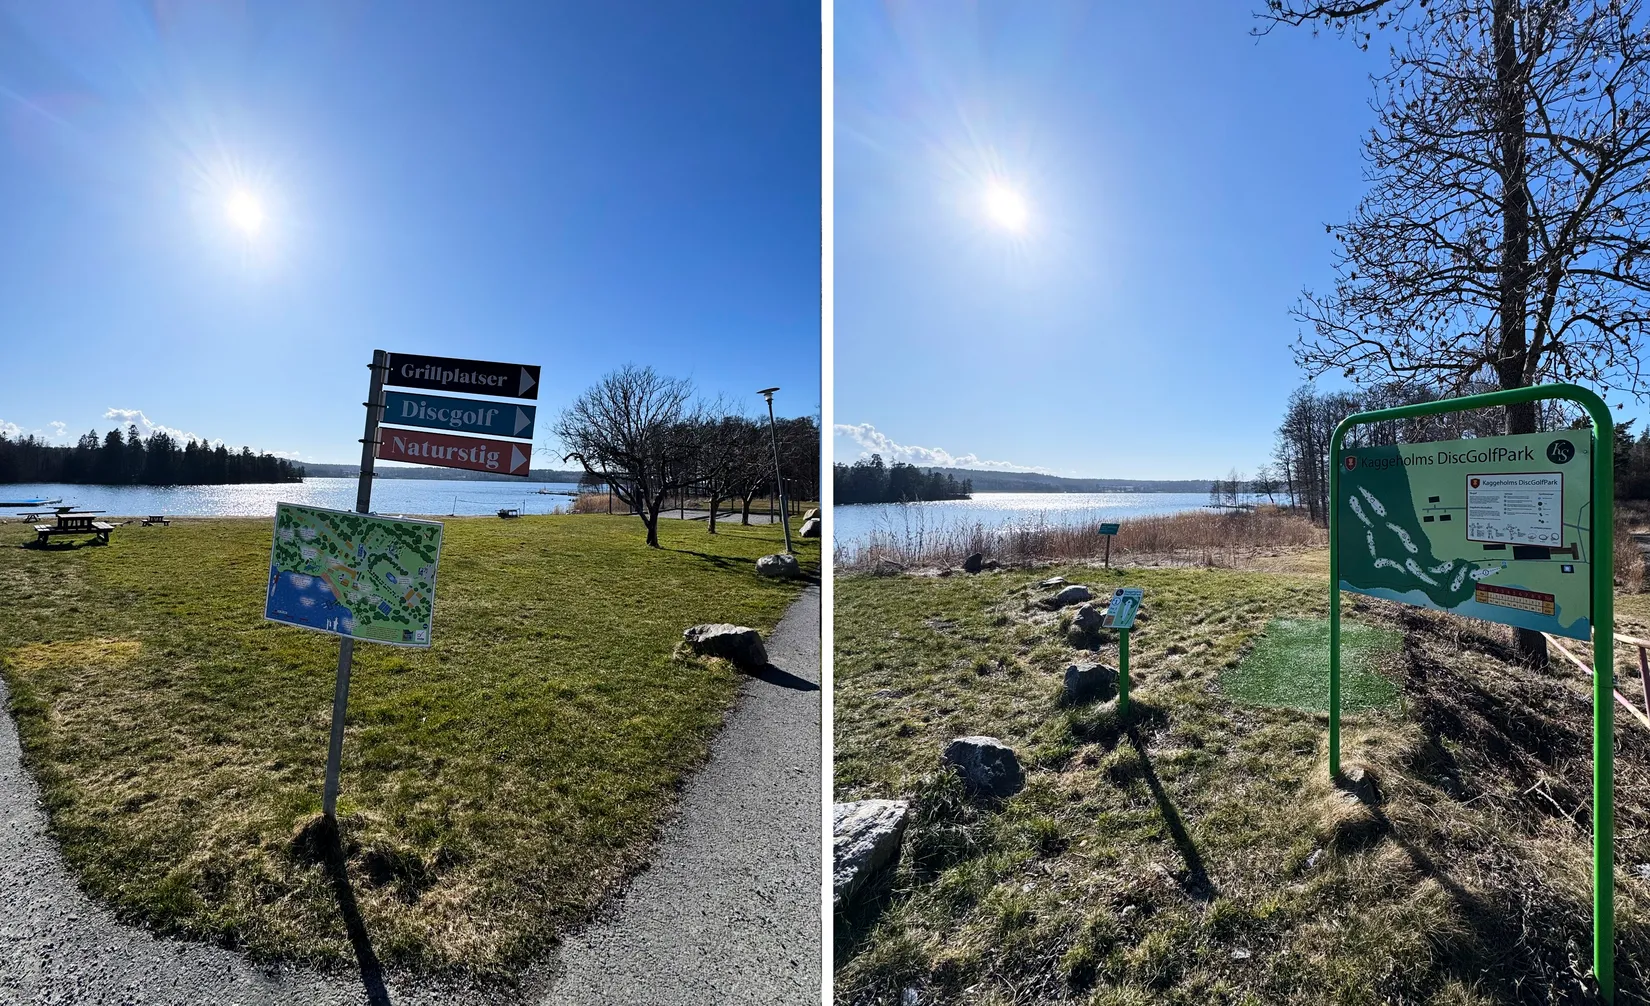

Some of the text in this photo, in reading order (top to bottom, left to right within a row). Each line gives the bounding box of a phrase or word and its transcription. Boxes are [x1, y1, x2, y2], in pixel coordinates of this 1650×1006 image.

[401, 363, 508, 387] Grillplatser
[401, 400, 499, 427] Discgolf
[391, 436, 500, 469] Naturstig
[1361, 446, 1535, 471] Kaggeholms DiscGolfPark
[1482, 478, 1558, 487] Kaggeholms DiscGolfPark
